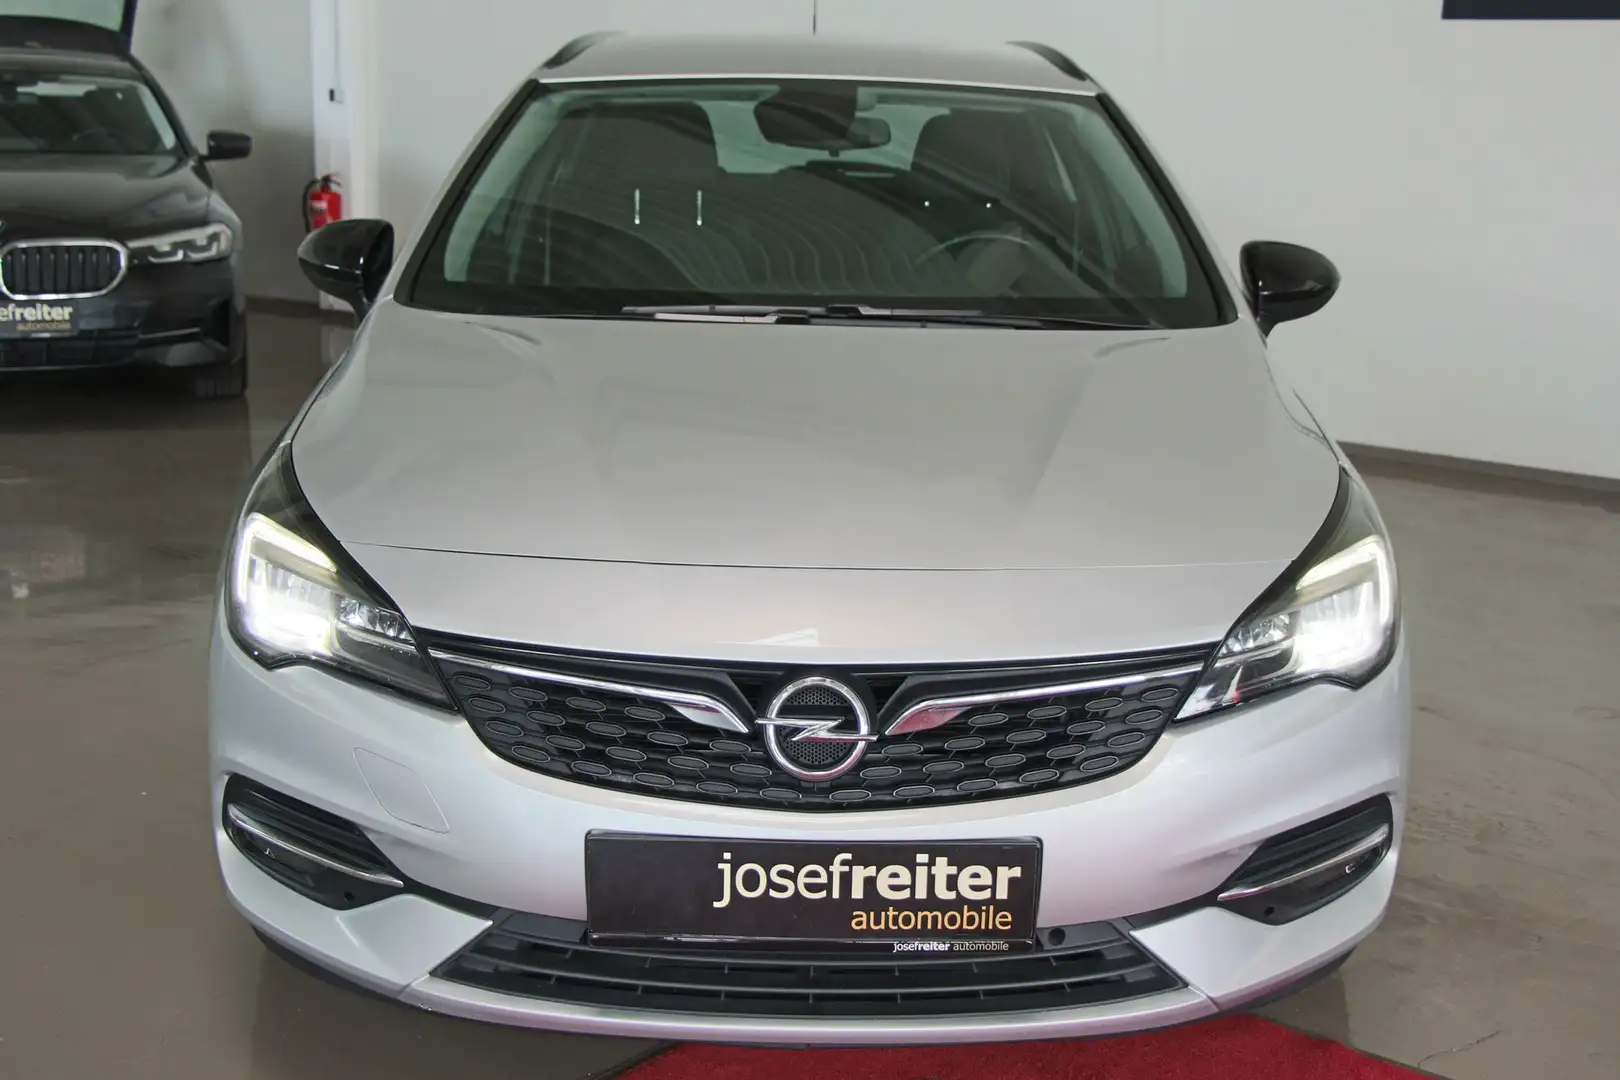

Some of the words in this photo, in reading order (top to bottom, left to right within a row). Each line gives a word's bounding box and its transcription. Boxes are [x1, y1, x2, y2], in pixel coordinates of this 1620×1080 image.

[713, 852, 1021, 908] josefreiter
[851, 906, 1012, 931] automobile
[893, 941, 950, 952] josefreiter
[953, 941, 1009, 951] automobile
